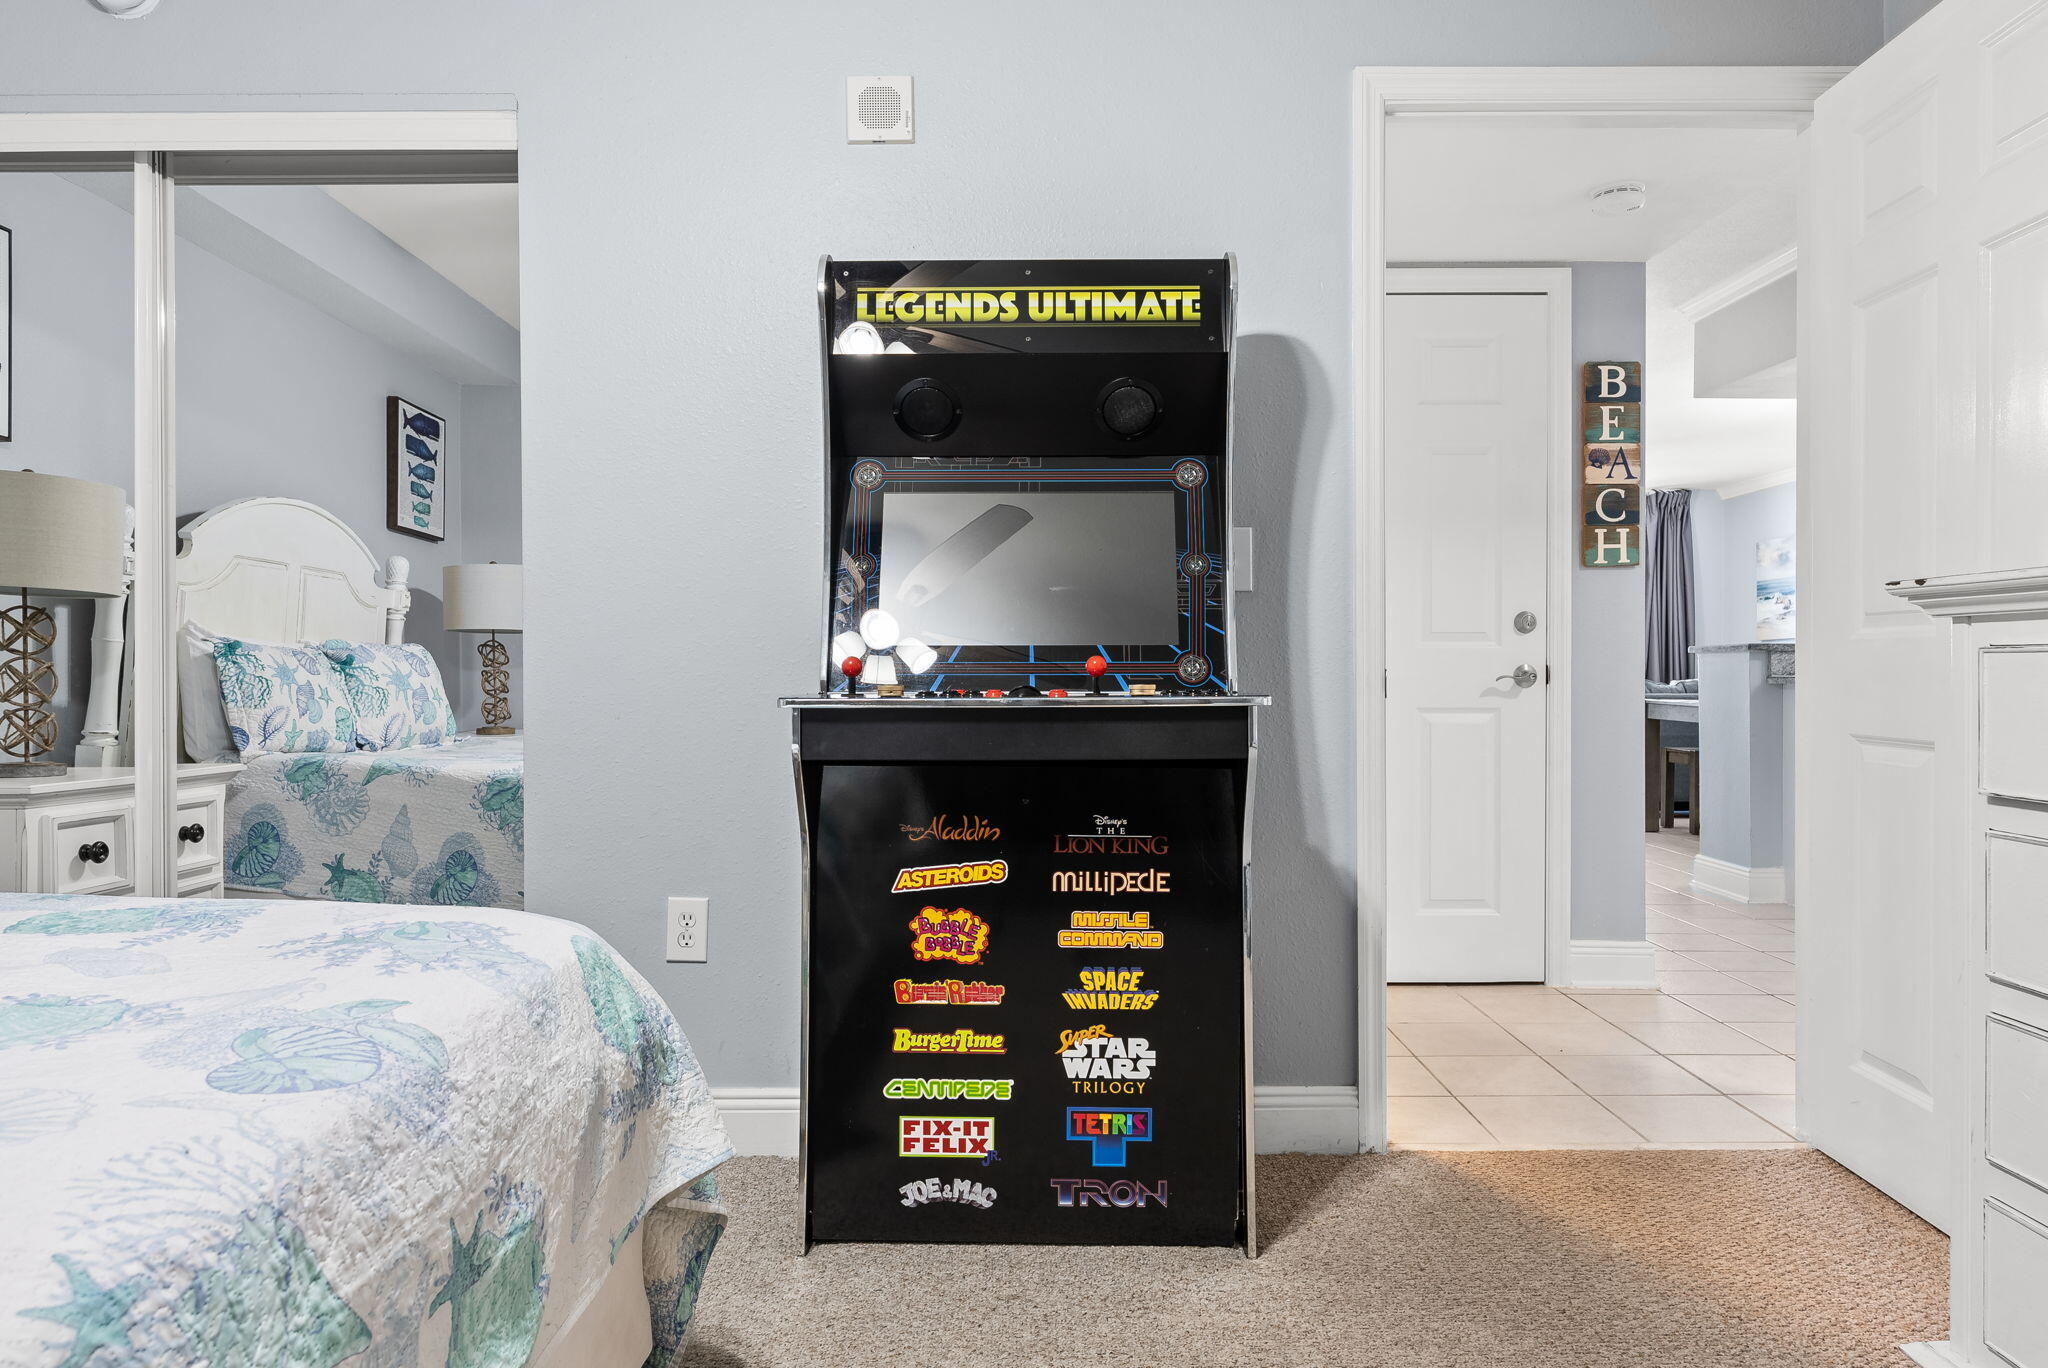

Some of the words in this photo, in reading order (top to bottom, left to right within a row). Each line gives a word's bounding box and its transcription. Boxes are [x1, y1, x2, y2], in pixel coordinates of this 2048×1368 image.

[857, 292, 1019, 322] LEGENDS
[1028, 291, 1201, 322] ULTIMATE
[1593, 365, 1638, 564] BEACH
[909, 815, 1000, 841] Aladdin
[1054, 835, 1108, 854] LION
[1111, 836, 1168, 854] KING
[897, 863, 1005, 889] ASTEROIDS
[918, 918, 981, 941] BUBBLE
[1073, 913, 1148, 927] MISSILE
[925, 936, 975, 955] BOBBLE
[1059, 932, 1162, 947] COMMAND
[1079, 967, 1144, 991] SPACE
[1062, 990, 1159, 1010] INVADERS
[1055, 1024, 1113, 1054] SUPER
[1062, 1038, 1156, 1058] STAR
[1062, 1058, 1156, 1079] WARS
[884, 1079, 1012, 1099] CENTIPEDE
[1072, 1082, 1146, 1094] TRILOGY
[903, 1120, 989, 1136] FIX-IT
[1072, 1113, 1146, 1135] TETRIS
[903, 1137, 989, 1153] FELIX
[900, 1178, 941, 1208] JOE
[953, 1178, 997, 1209] MAC
[1050, 1179, 1168, 1208] TRON
